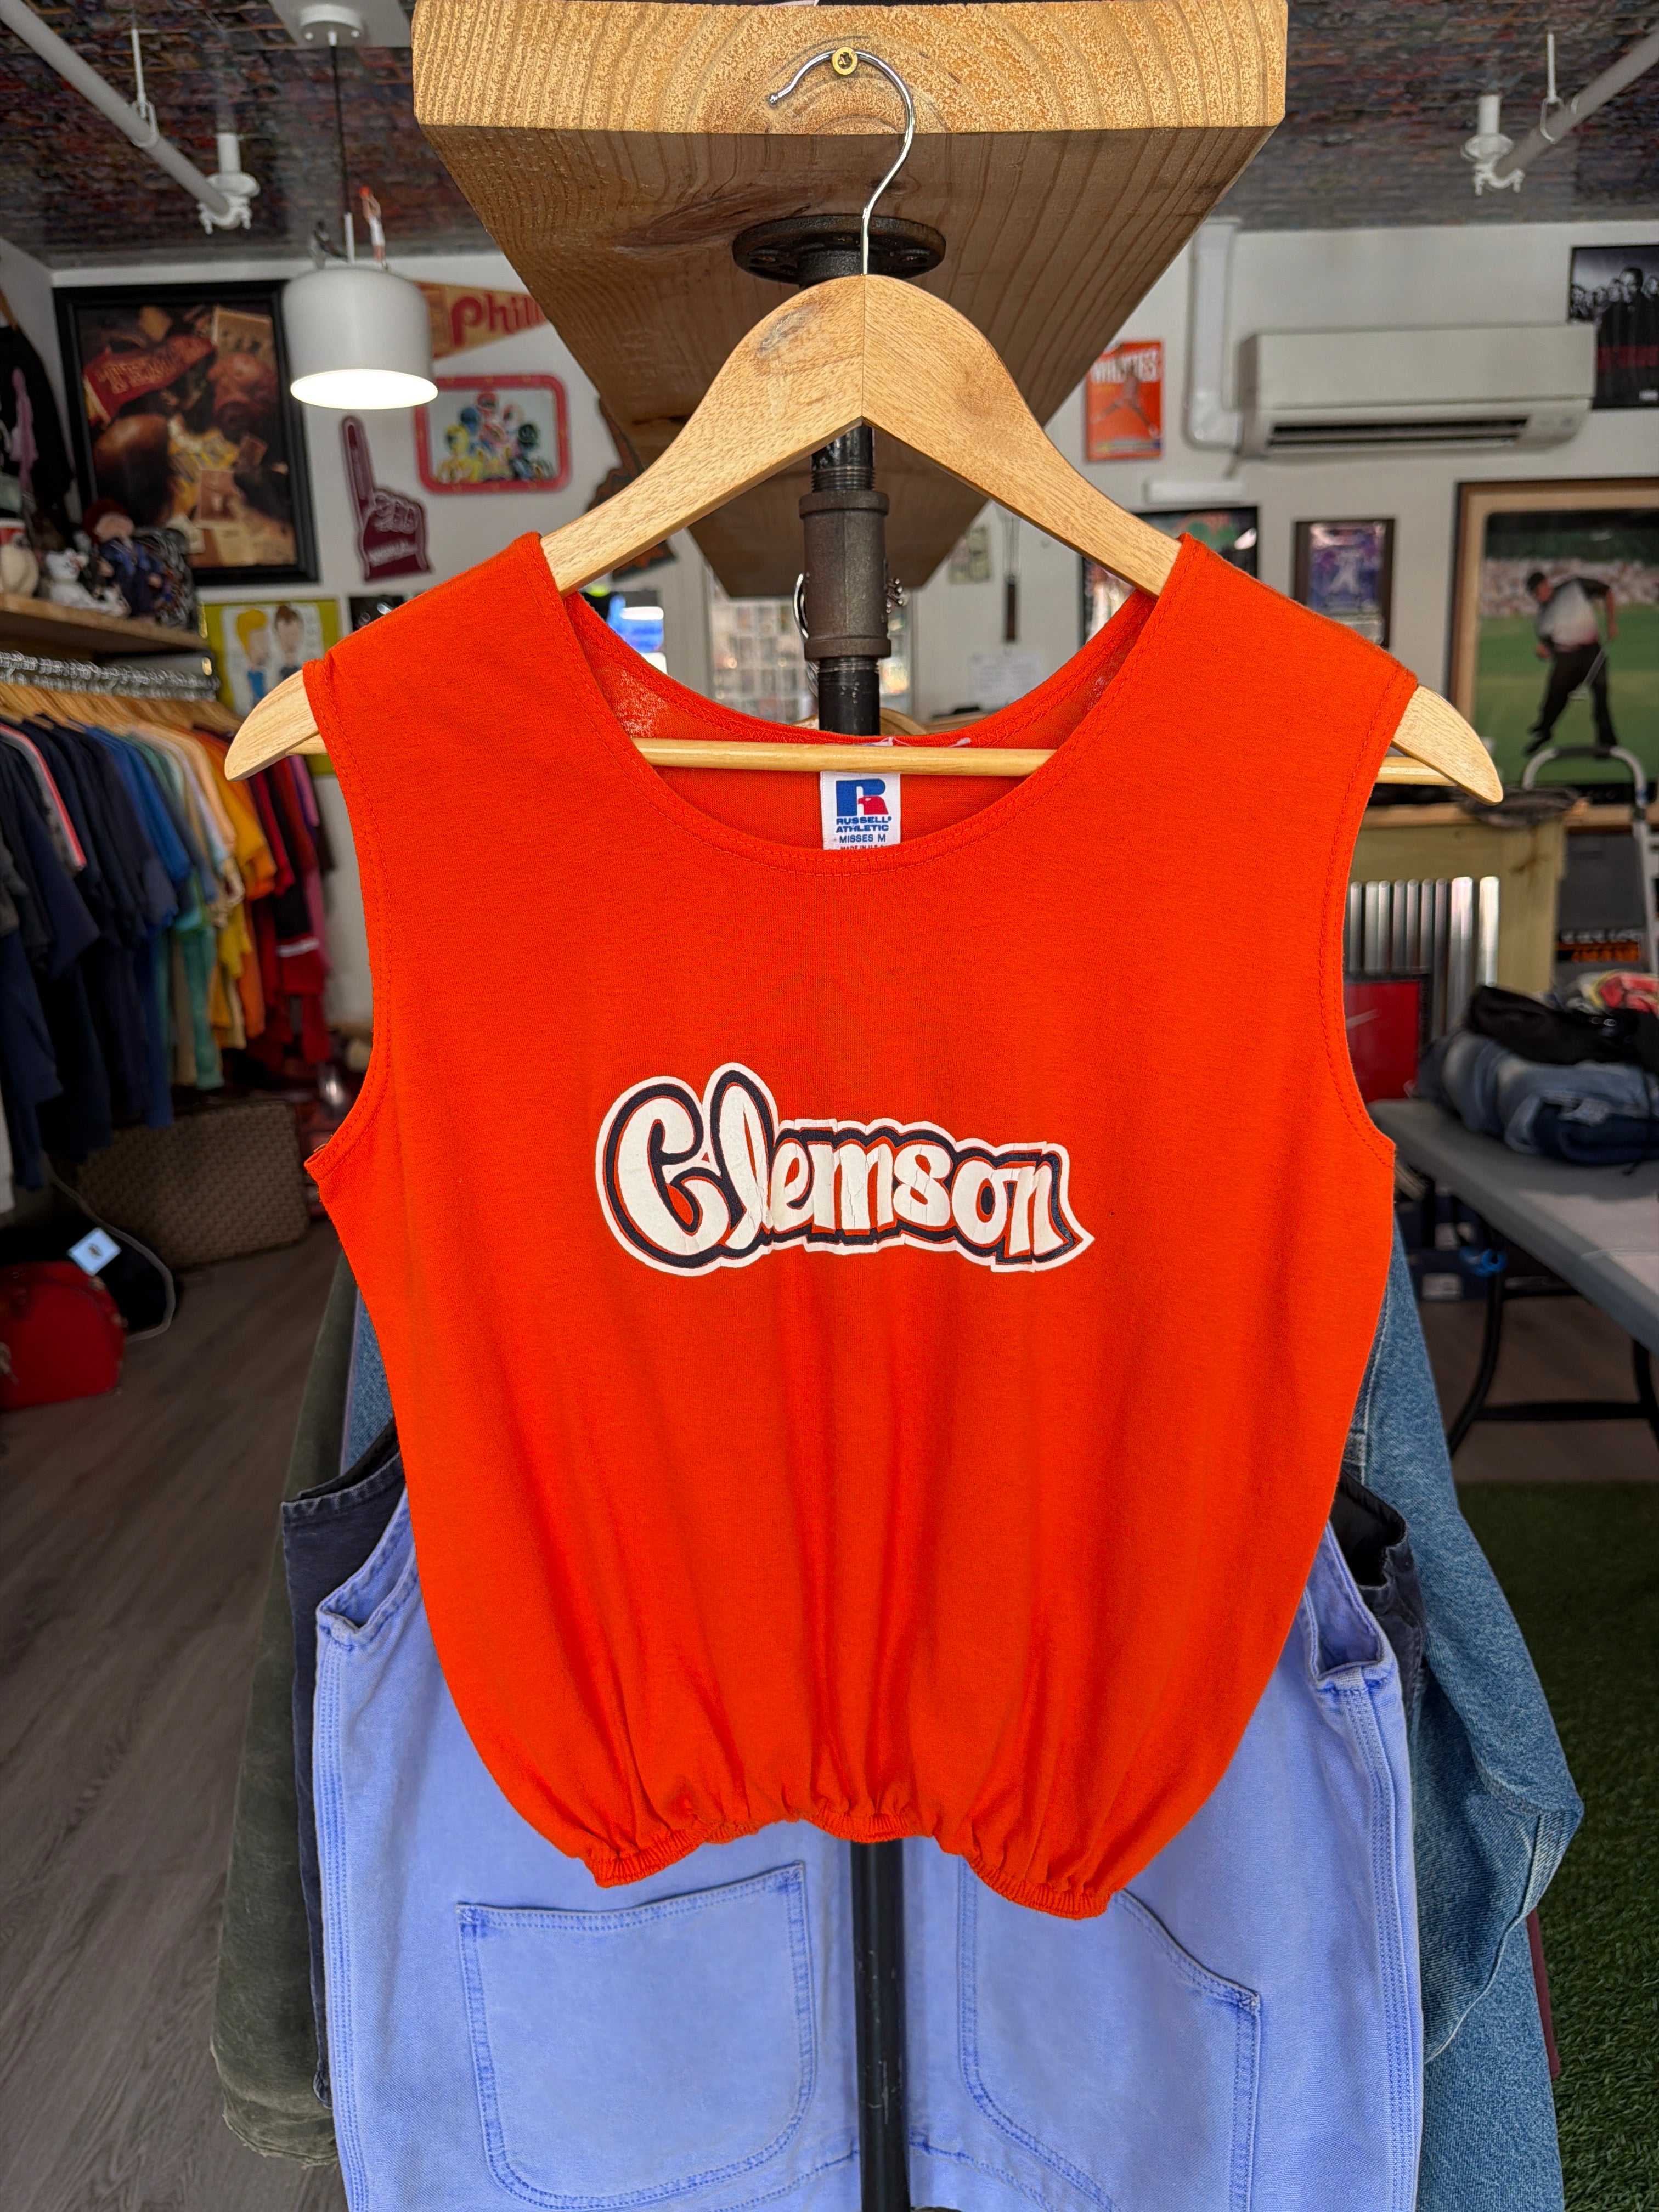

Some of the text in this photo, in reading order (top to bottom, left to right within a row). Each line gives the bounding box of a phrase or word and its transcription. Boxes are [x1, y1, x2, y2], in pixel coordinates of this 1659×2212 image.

[836, 825, 889, 833] ATHLETIC
[839, 833, 886, 843] MISSES M
[598, 1064, 1092, 1275] Clemson
